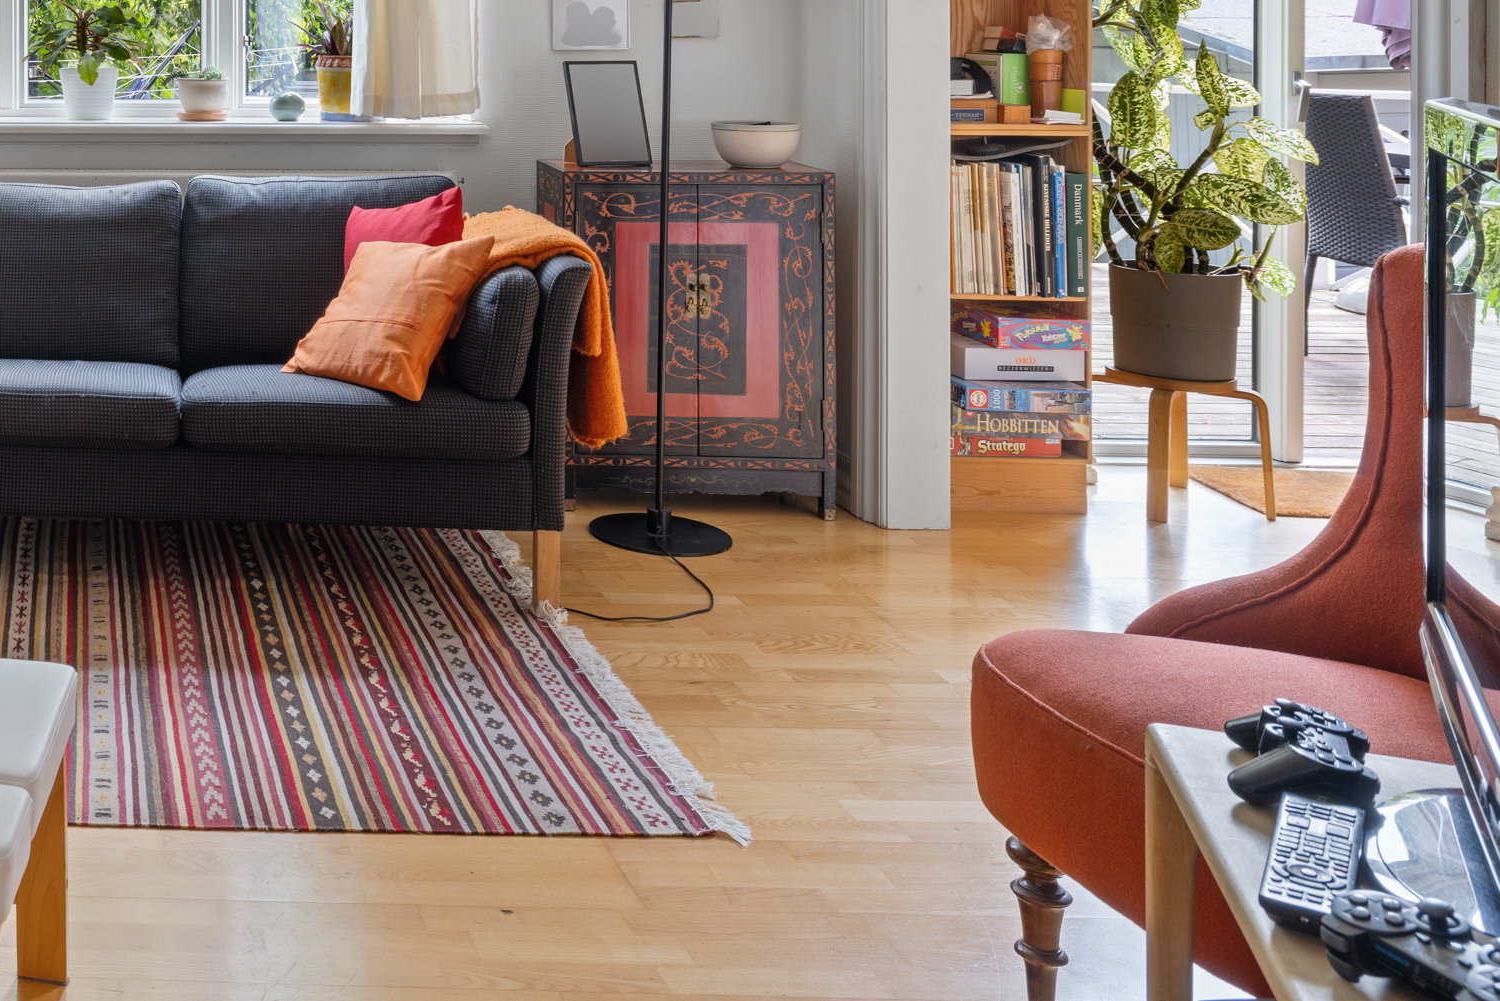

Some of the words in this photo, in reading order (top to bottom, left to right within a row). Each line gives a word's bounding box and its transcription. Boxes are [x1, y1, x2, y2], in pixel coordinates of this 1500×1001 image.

[1074, 183, 1084, 225] Danmark
[1015, 357, 1037, 365] ORD
[976, 412, 1059, 434] HOBBITTEN
[977, 440, 1026, 454] Stratego
